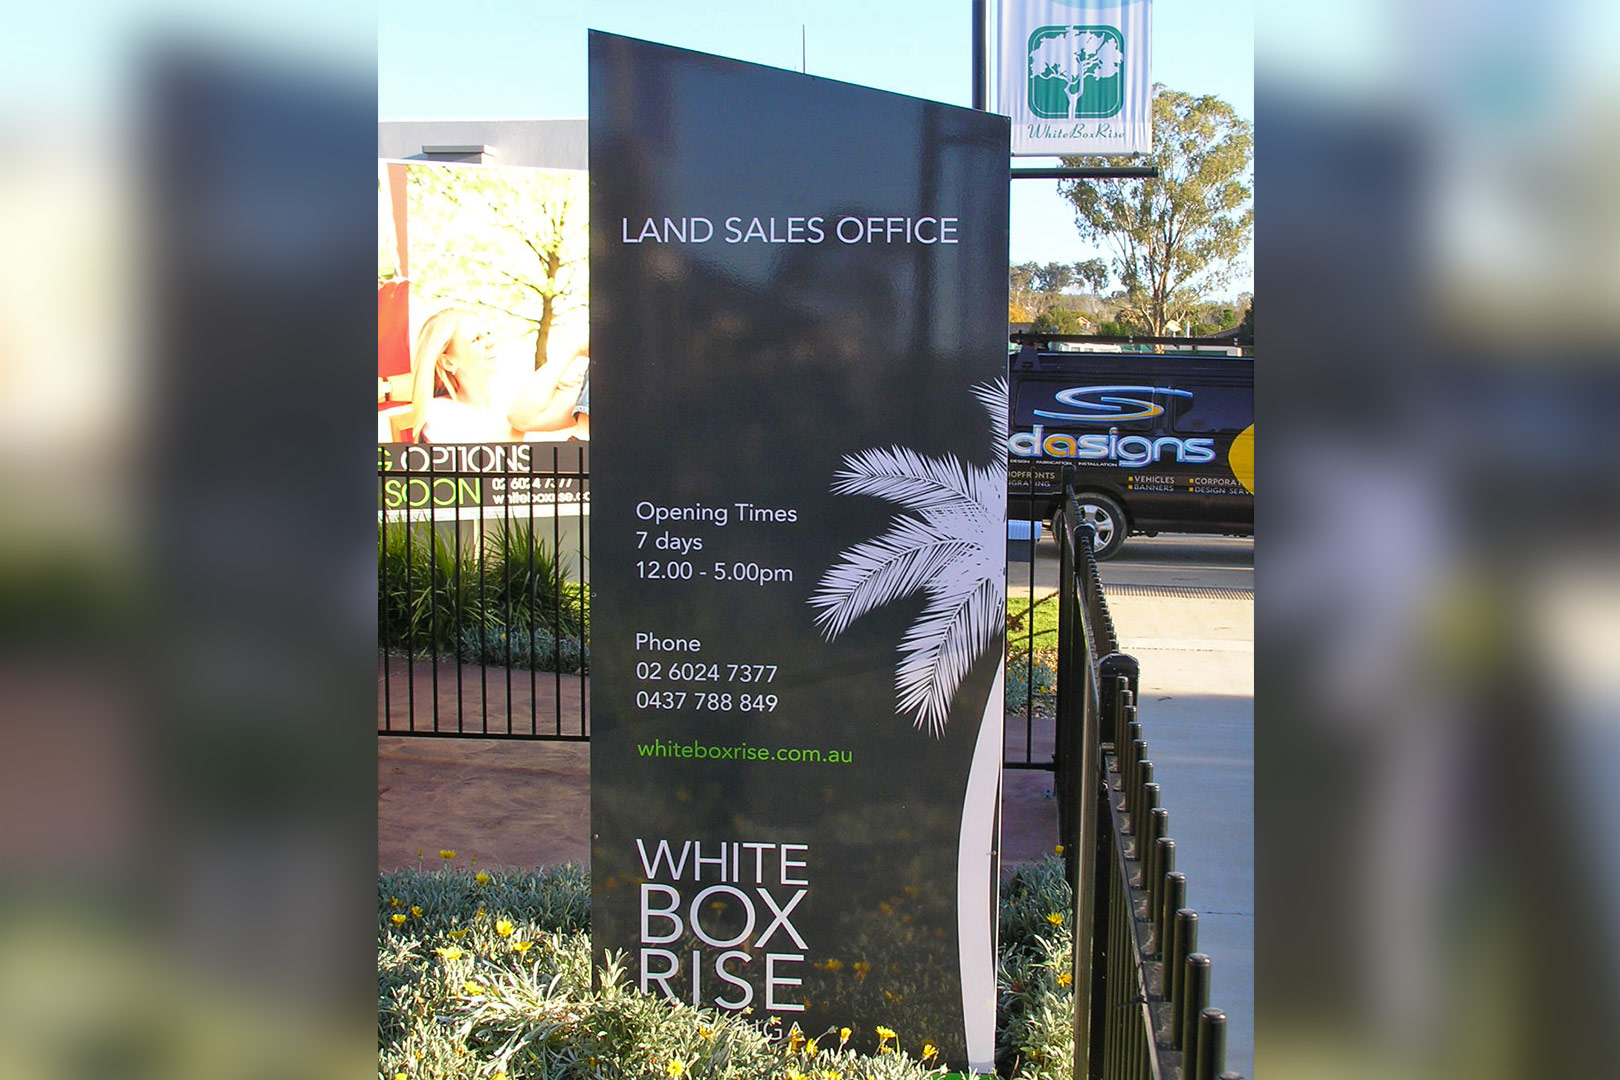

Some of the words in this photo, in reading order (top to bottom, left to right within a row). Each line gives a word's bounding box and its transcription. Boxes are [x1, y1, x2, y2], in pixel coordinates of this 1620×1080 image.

[622, 217, 714, 244] LAND
[724, 217, 826, 244] SALES
[836, 217, 959, 245] OFFICE
[400, 444, 531, 473] OPTIONS
[1008, 424, 1217, 468] dasigns
[384, 477, 482, 508] SOON
[1134, 475, 1175, 485] VEHICLES
[1134, 483, 1175, 492] BANNERS
[1194, 486, 1226, 495] DESIGN
[636, 501, 728, 526] Opening
[735, 502, 798, 523] Times
[635, 531, 648, 550] 7
[655, 531, 703, 555] days
[636, 561, 693, 580] 12.00
[713, 562, 793, 586] 5.00pm
[635, 632, 702, 652] Phone
[636, 662, 662, 680] 02
[668, 663, 720, 682] 6024
[727, 665, 779, 683] 7377
[636, 690, 687, 709] 0437
[694, 693, 733, 711] 788
[739, 694, 779, 712] 849
[637, 739, 854, 763] whiteboxrise.com.au
[635, 838, 809, 886] WHITE
[640, 883, 810, 950] BOX
[640, 948, 805, 1012] RISE
